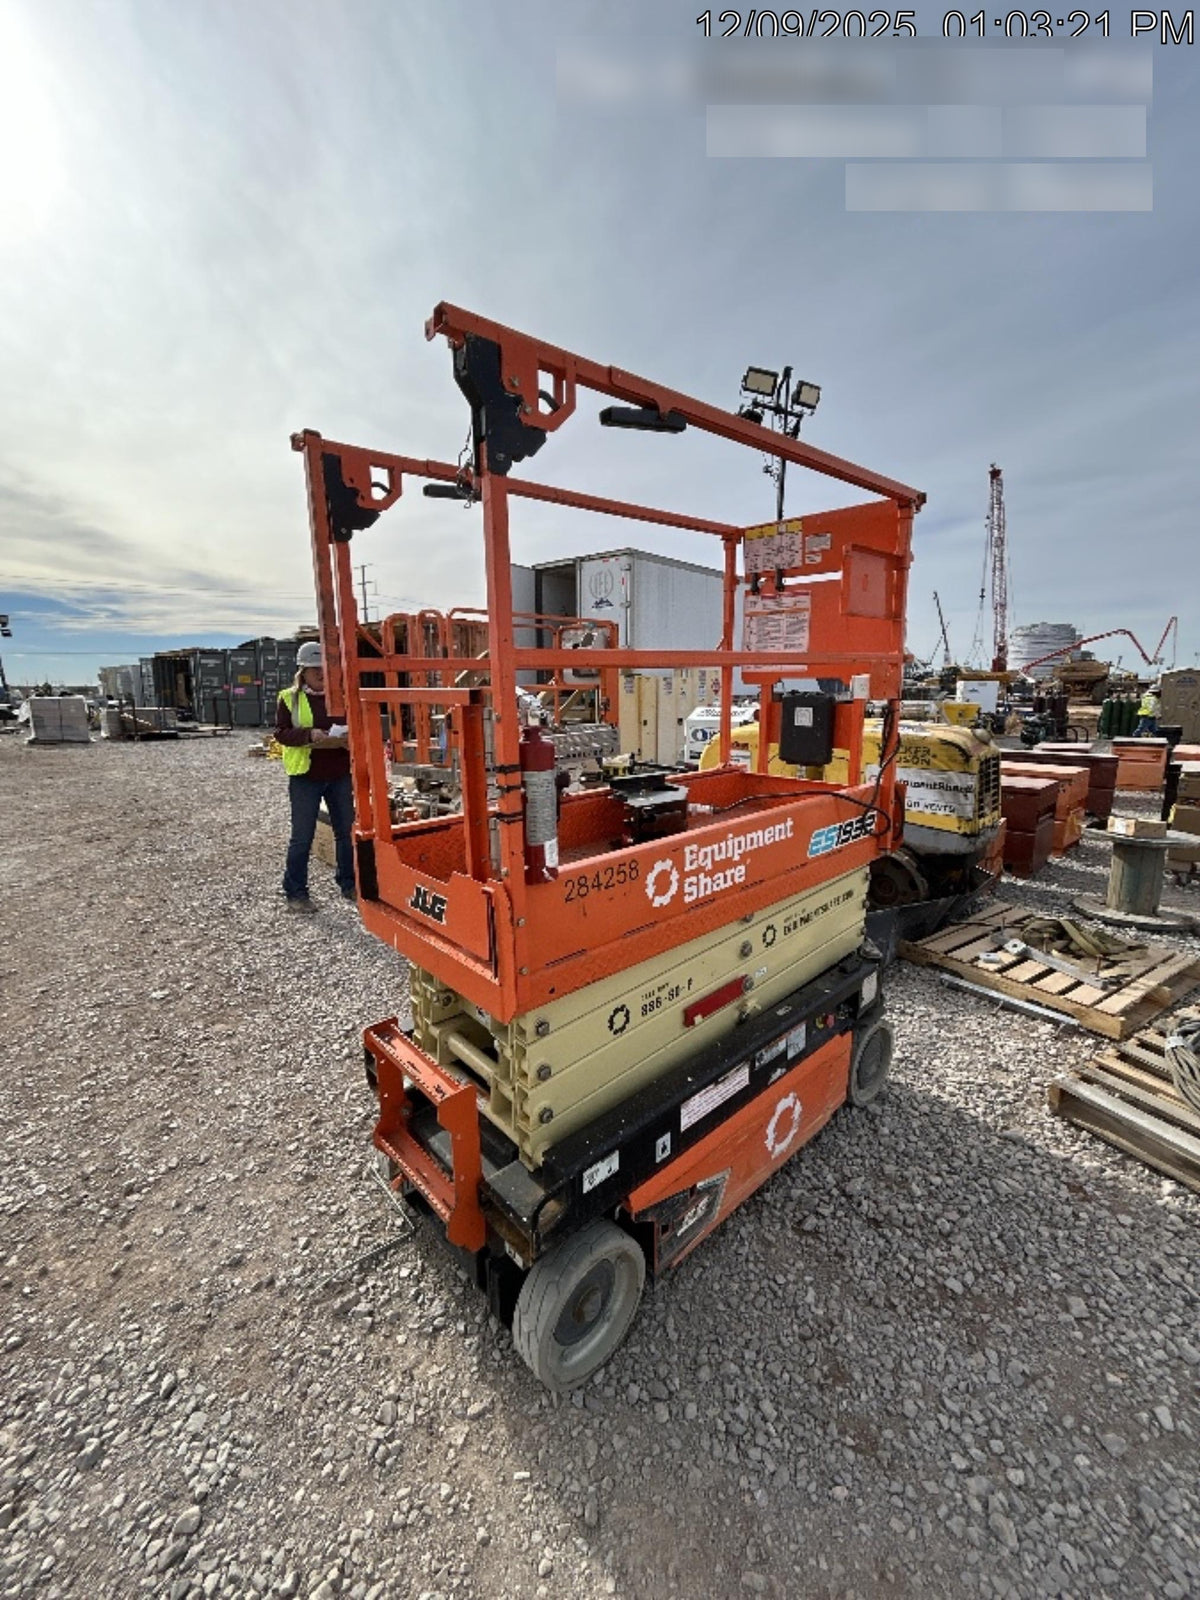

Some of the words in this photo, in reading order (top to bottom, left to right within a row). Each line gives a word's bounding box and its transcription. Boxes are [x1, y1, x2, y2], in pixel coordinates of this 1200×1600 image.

[684, 817, 794, 872] Equipment
[564, 859, 640, 904] 284258
[684, 864, 746, 904] Share
[408, 883, 448, 925] JLG
